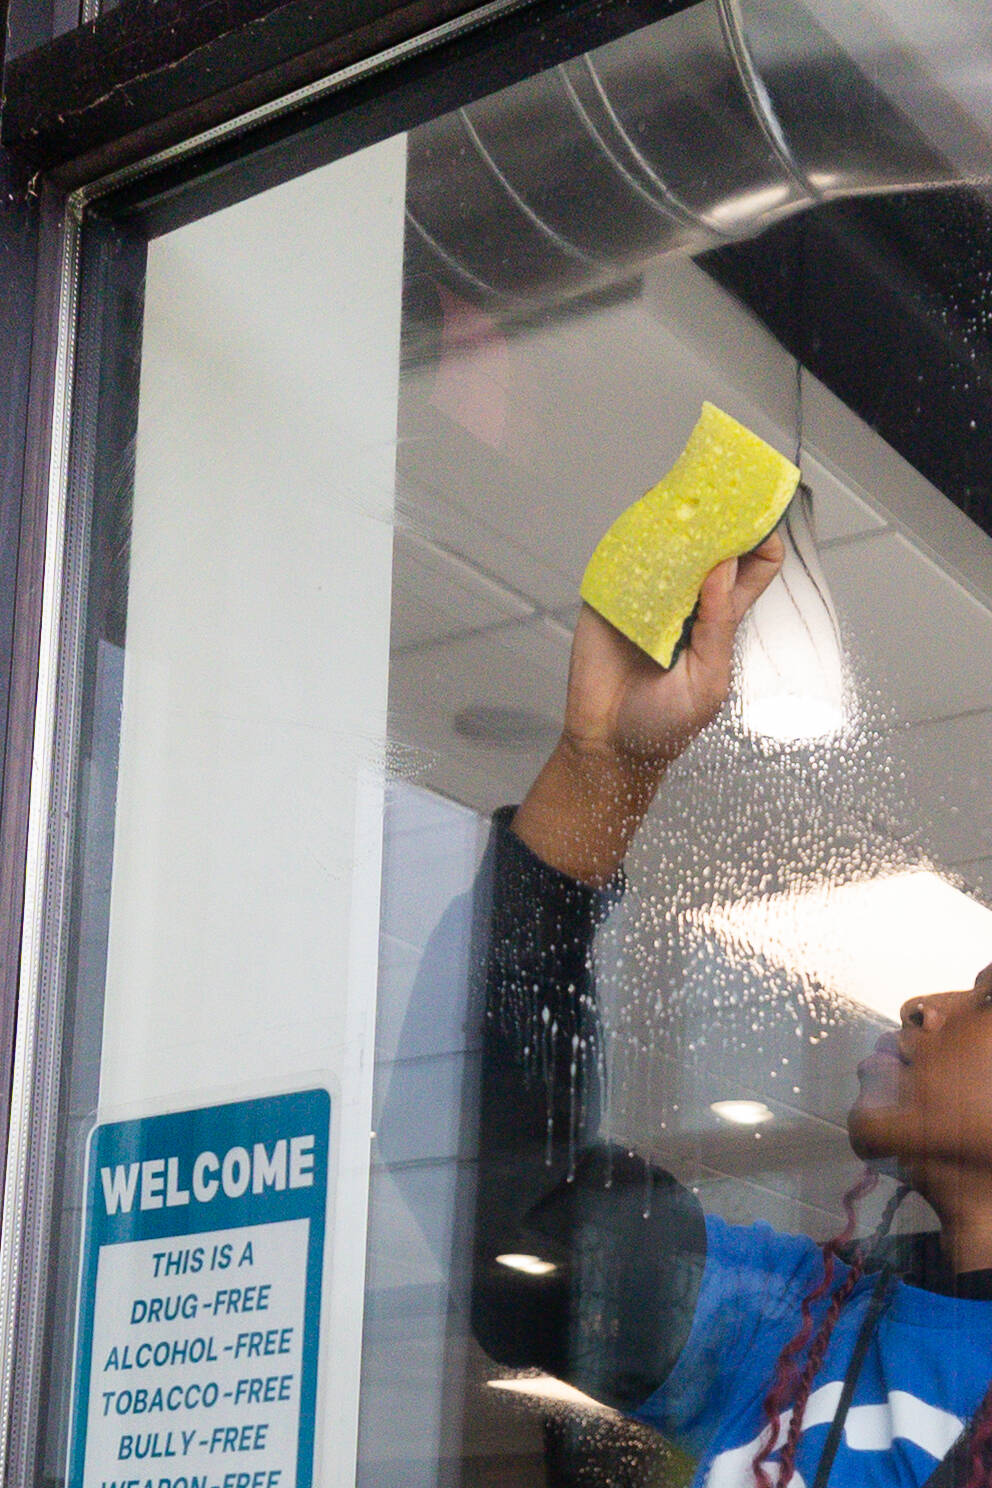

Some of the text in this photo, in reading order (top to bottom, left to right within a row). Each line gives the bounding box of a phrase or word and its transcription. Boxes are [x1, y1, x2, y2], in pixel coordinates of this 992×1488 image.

[100, 1134, 315, 1215] WELCOME
[152, 1241, 254, 1278] THIS IS A
[130, 1284, 272, 1325] DRUG-FREE
[103, 1327, 294, 1372] ALCOHOL-FREE
[101, 1374, 294, 1417] TOBACCO-FREE
[117, 1423, 270, 1461] BULLY-FREE
